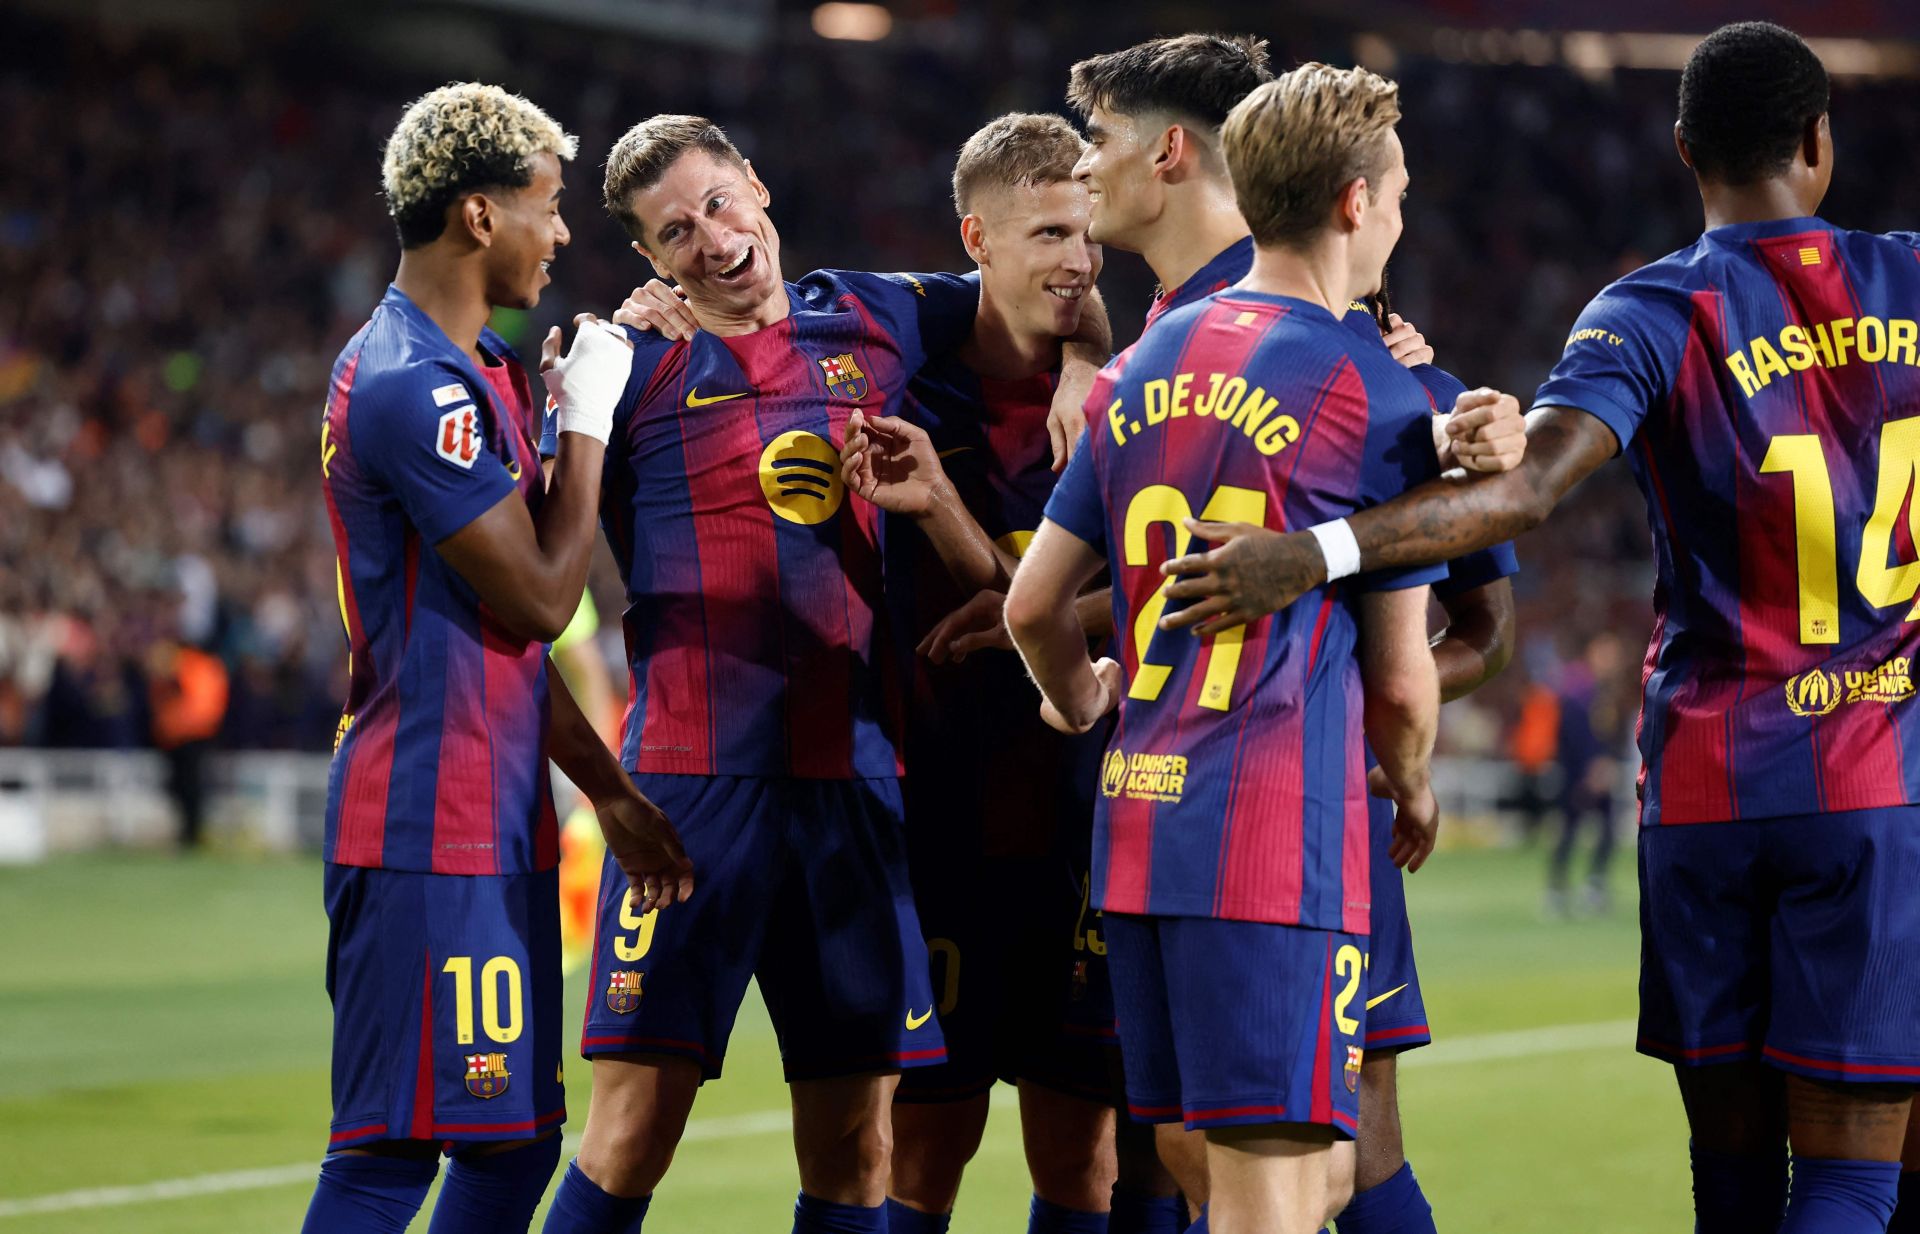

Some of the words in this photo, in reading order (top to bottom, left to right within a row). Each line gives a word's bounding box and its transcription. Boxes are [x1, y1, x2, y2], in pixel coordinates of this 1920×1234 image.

[1565, 328, 1607, 348] LIGHT
[1608, 333, 1624, 347] tv
[1725, 316, 1920, 399] RASHFOR
[1108, 398, 1142, 447] F.
[1143, 373, 1195, 426] DE
[1194, 373, 1300, 456] JONG
[1124, 484, 1266, 711] 21
[1125, 773, 1184, 794] ACNUR
[1130, 753, 1188, 776] UNHCR
[613, 882, 659, 962] 9
[442, 956, 524, 1045] 10
[1335, 944, 1369, 1036] 2
